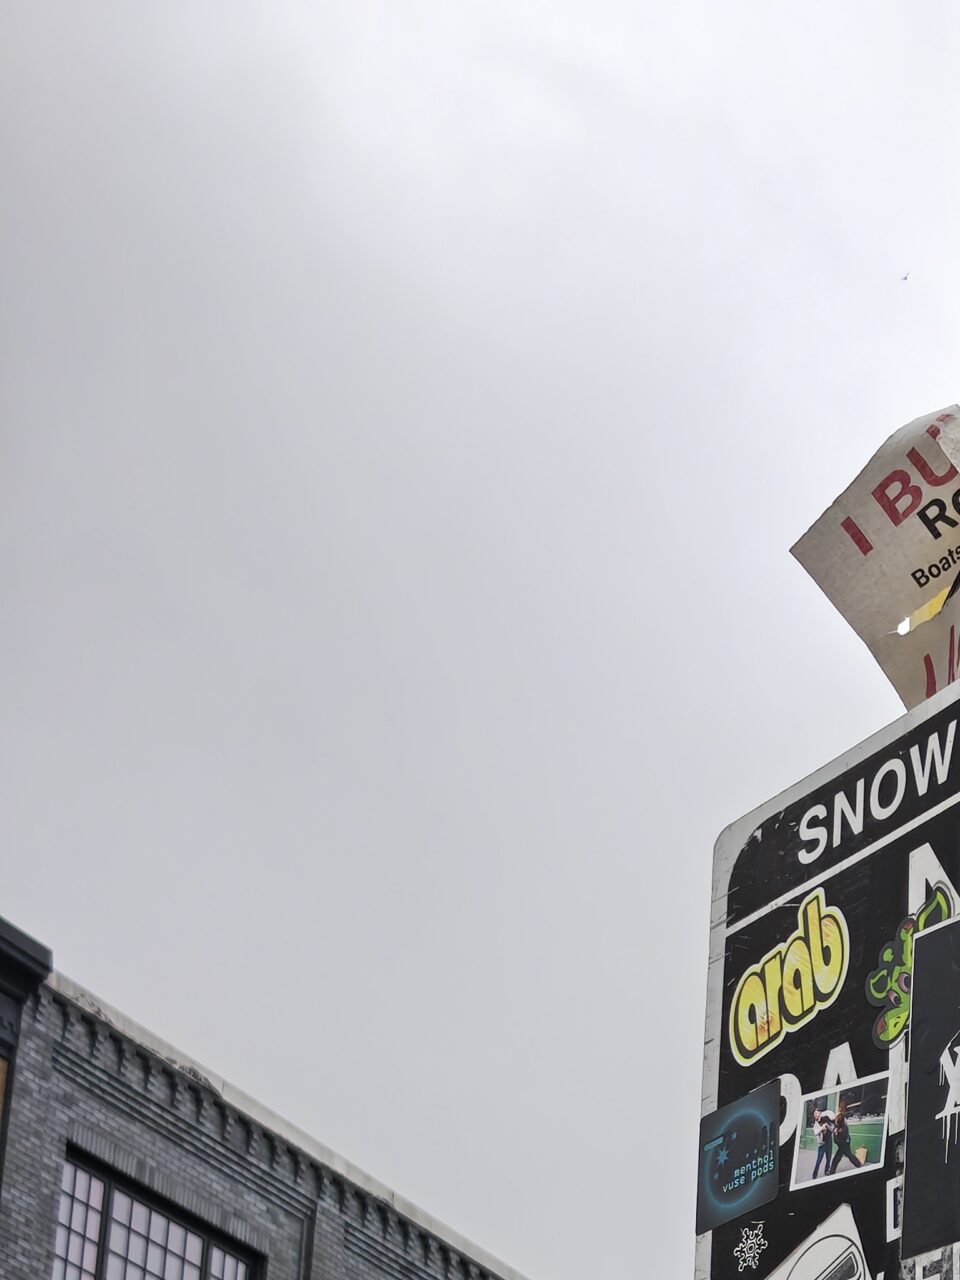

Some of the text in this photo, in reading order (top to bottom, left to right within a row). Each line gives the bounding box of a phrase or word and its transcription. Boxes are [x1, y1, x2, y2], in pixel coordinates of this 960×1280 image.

[871, 412, 959, 527] BU
[798, 721, 956, 865] SNOW
[722, 1161, 775, 1193] vuse pods
[734, 1150, 774, 1178] menthol
